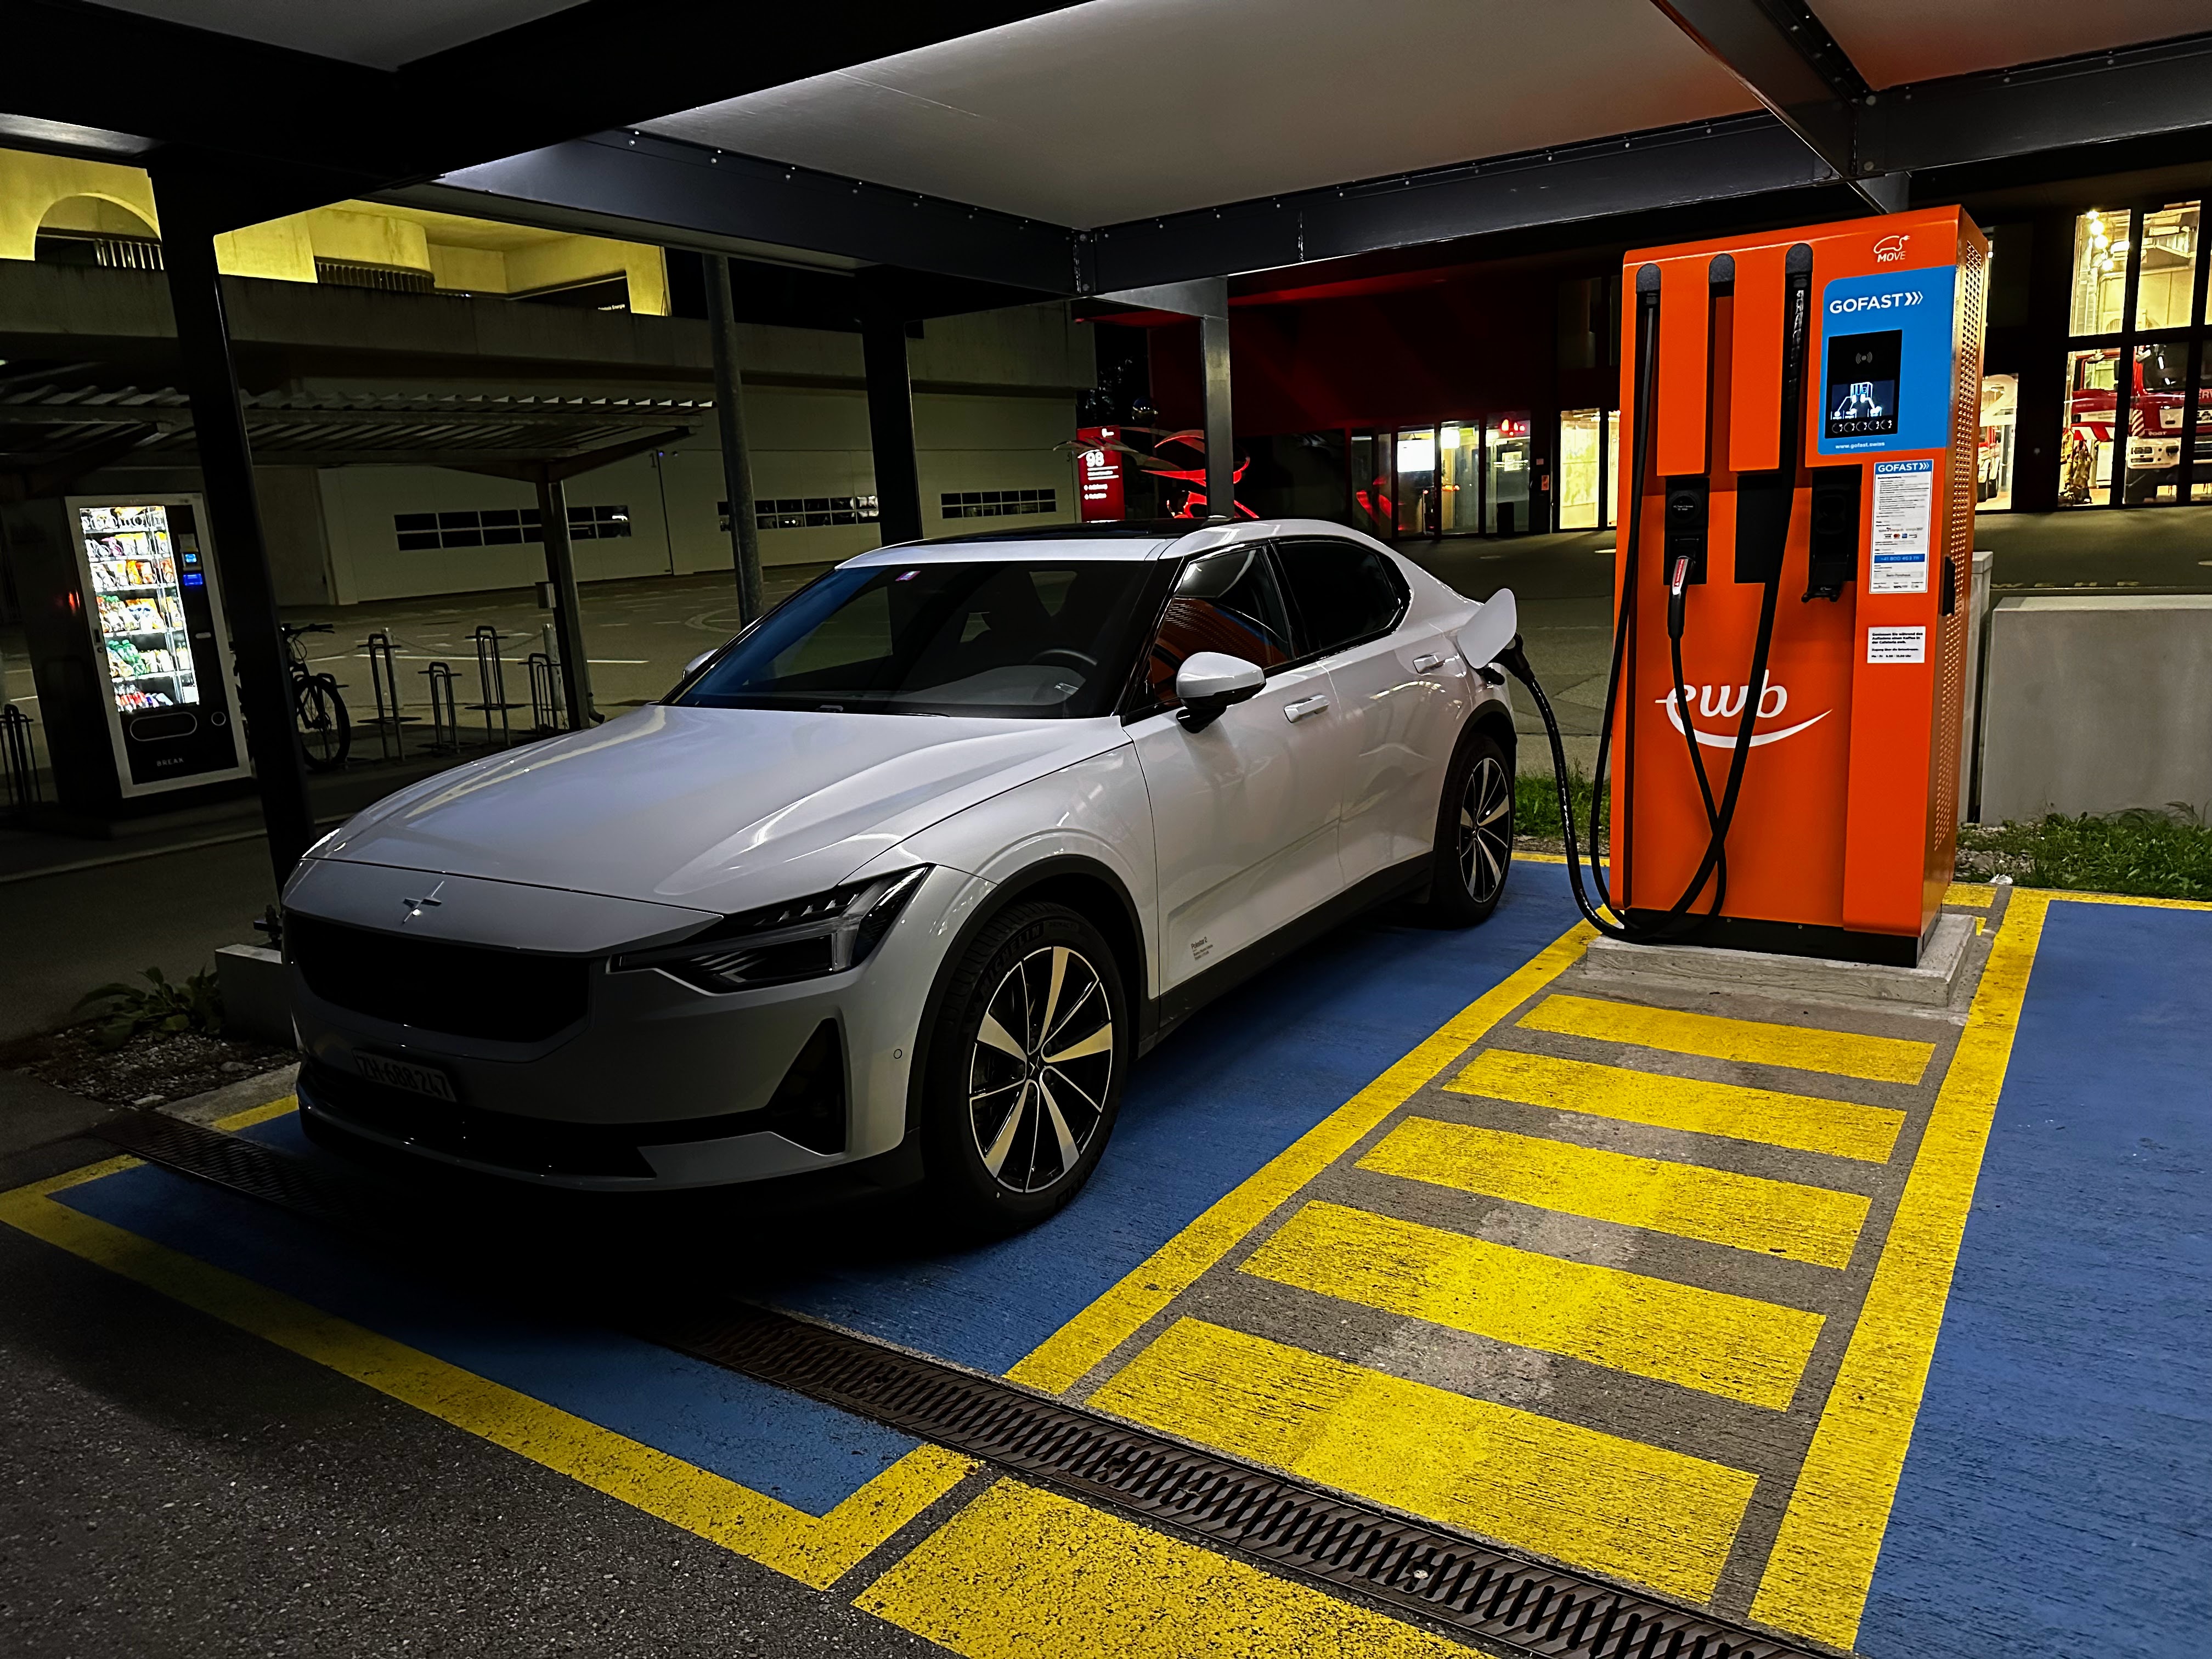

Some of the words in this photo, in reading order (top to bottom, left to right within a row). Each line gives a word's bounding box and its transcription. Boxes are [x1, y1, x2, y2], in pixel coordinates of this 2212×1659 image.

[1877, 251, 1906, 262] MOVE
[1830, 293, 1903, 314] GOFAST
[1979, 374, 2017, 427] 2
[1835, 441, 1886, 449] www.gofast.swiss
[1086, 451, 1104, 467] 98
[1878, 462, 1918, 472] GOFAST
[156, 757, 184, 766] BREAK
